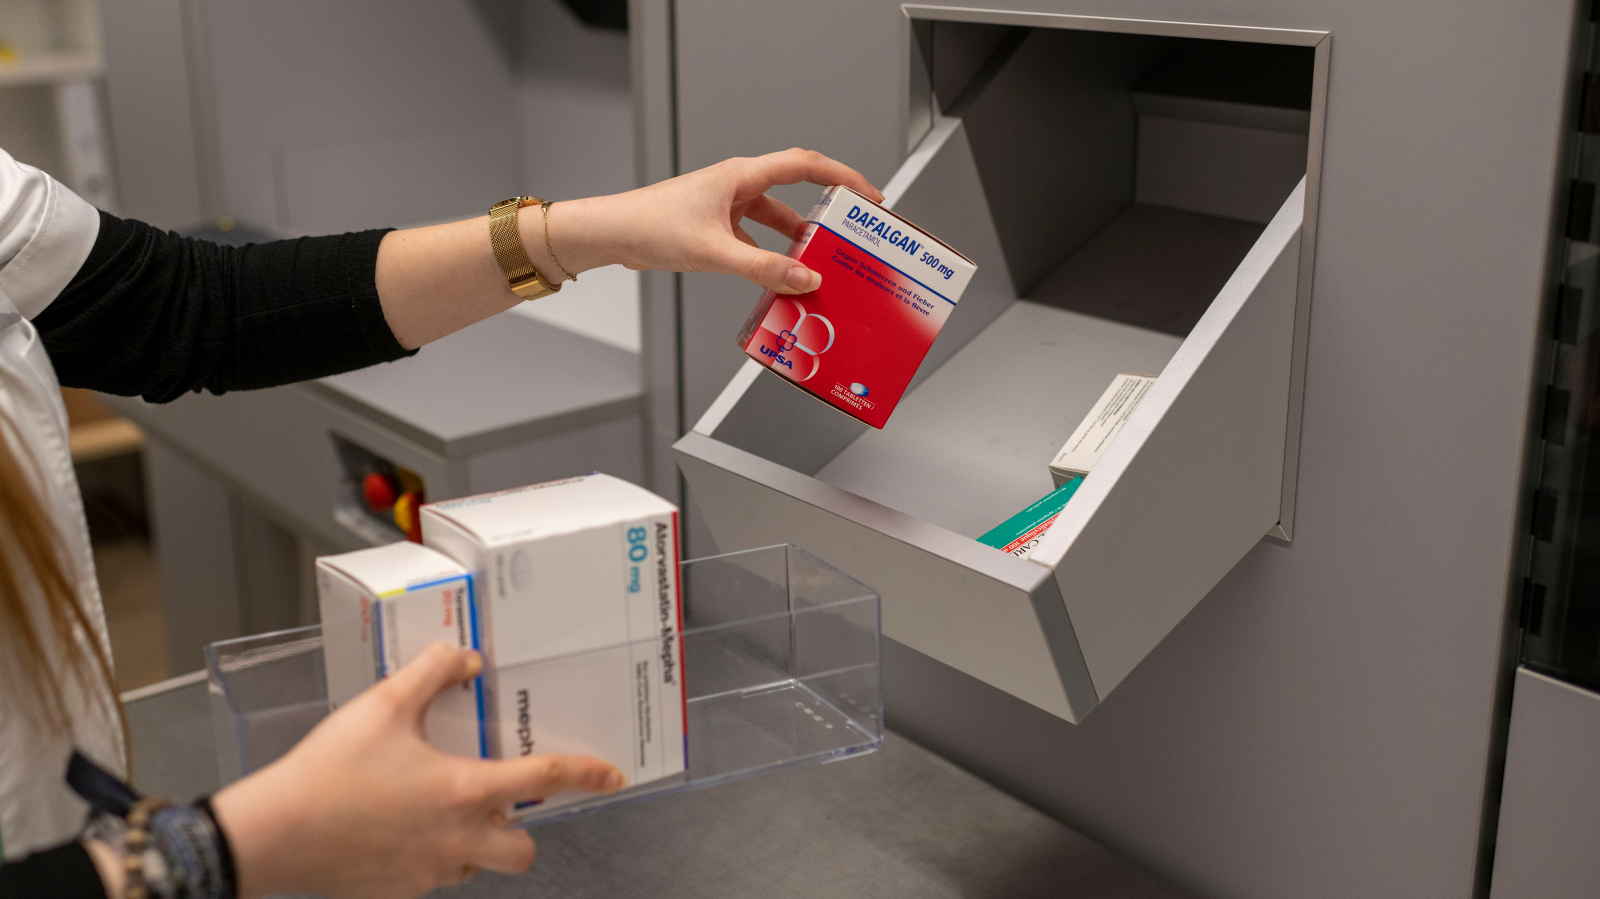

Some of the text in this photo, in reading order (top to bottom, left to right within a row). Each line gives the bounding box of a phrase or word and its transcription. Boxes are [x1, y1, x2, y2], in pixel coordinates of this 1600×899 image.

[841, 219, 881, 248] PARACETAMOL
[831, 255, 854, 272] Contre
[854, 269, 865, 279] les
[865, 276, 894, 296] douleurs
[895, 293, 903, 301] et
[903, 297, 911, 305] la
[835, 248, 935, 310] Gegen Schmerzen und Fieber
[919, 252, 940, 268] 500
[937, 264, 955, 280] mg
[760, 345, 793, 370] UPSA
[834, 384, 844, 393] 100
[843, 389, 872, 409] TABLETTEN
[627, 526, 649, 594] 80 mg
[1009, 541, 1020, 550] 100
[516, 688, 534, 757] meph
